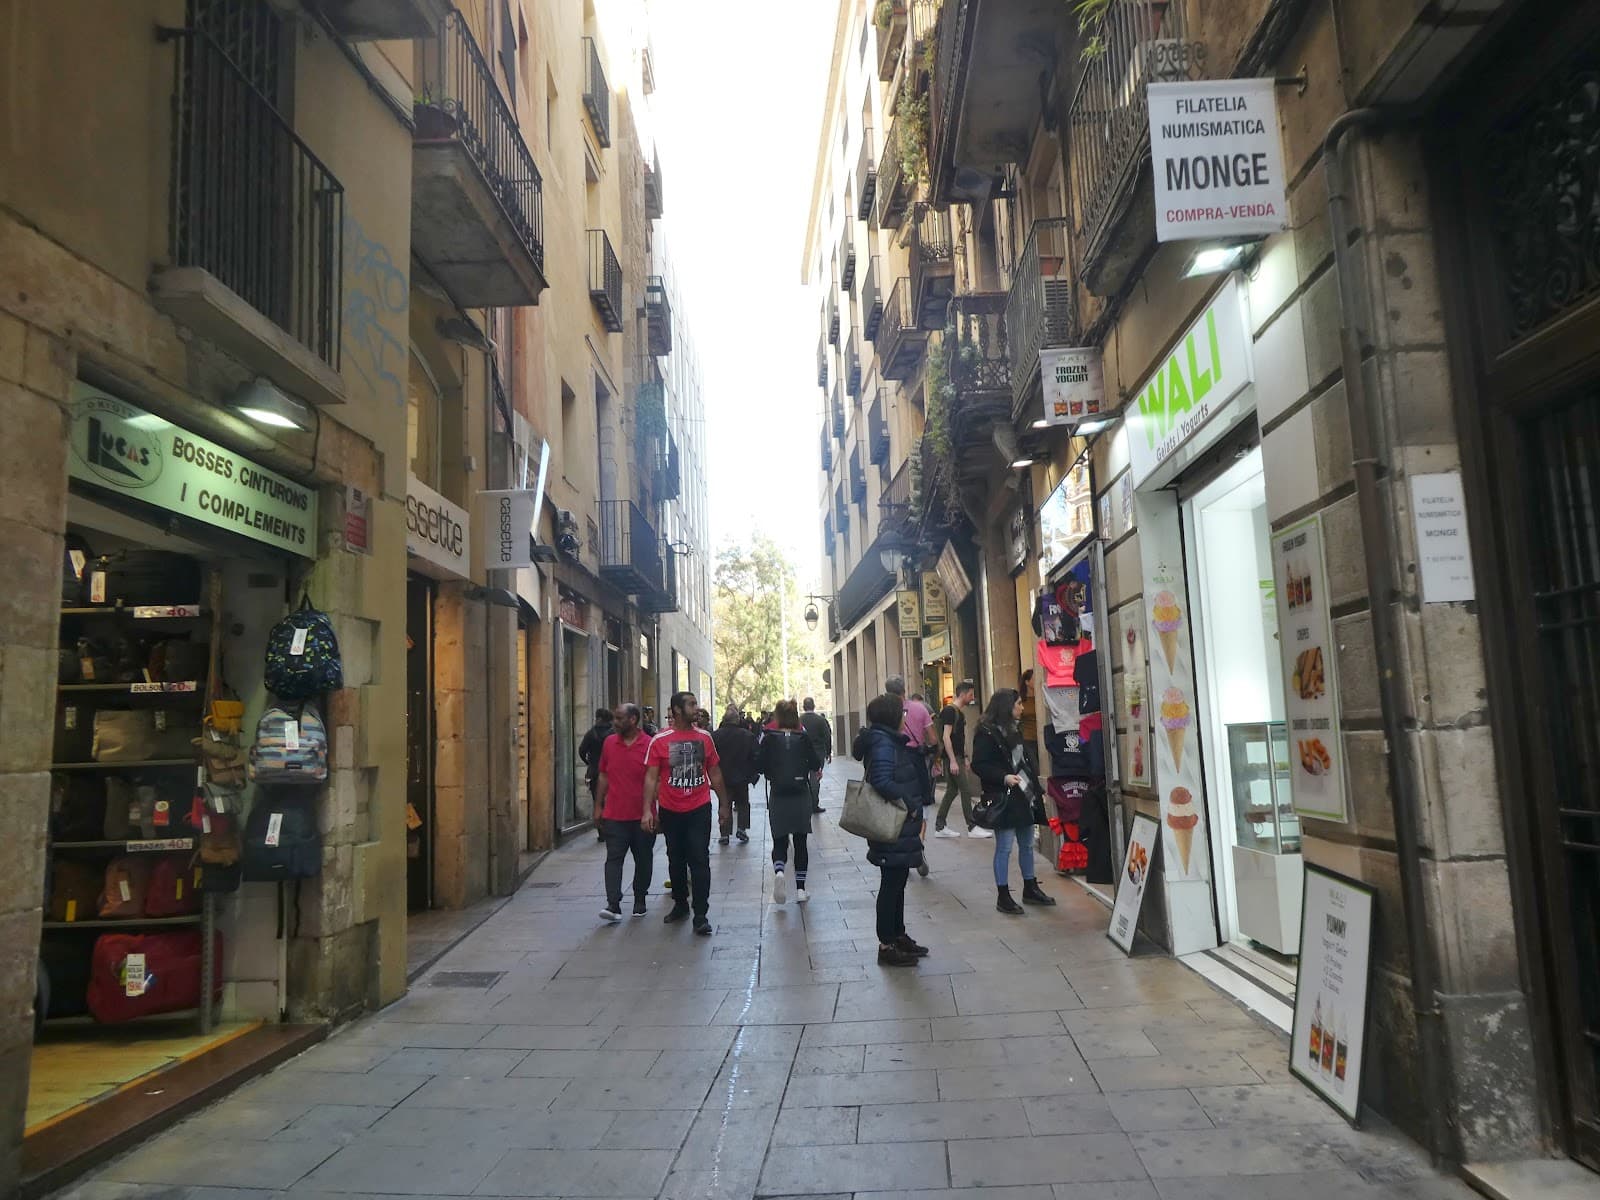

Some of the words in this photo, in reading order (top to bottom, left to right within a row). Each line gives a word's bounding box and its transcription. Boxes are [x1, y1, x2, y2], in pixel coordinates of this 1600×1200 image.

[1176, 96, 1247, 114] FILATELIA
[1162, 119, 1265, 139] NUMISMATICA
[1165, 152, 1269, 191] MONGE
[1166, 203, 1275, 223] COMPRA-VENDA
[1055, 365, 1088, 375] FROZEN
[1055, 374, 1089, 384] YOGURT
[1137, 307, 1222, 451] WALI
[1182, 404, 1208, 437] Yogurts
[239, 467, 308, 512] CINTURONS
[198, 489, 306, 545] COMPLEMENTS
[500, 497, 512, 562] cassette
[1425, 527, 1458, 537] MONGE
[668, 775, 705, 787] FEARLESS
[1326, 913, 1347, 939] YUMMY
